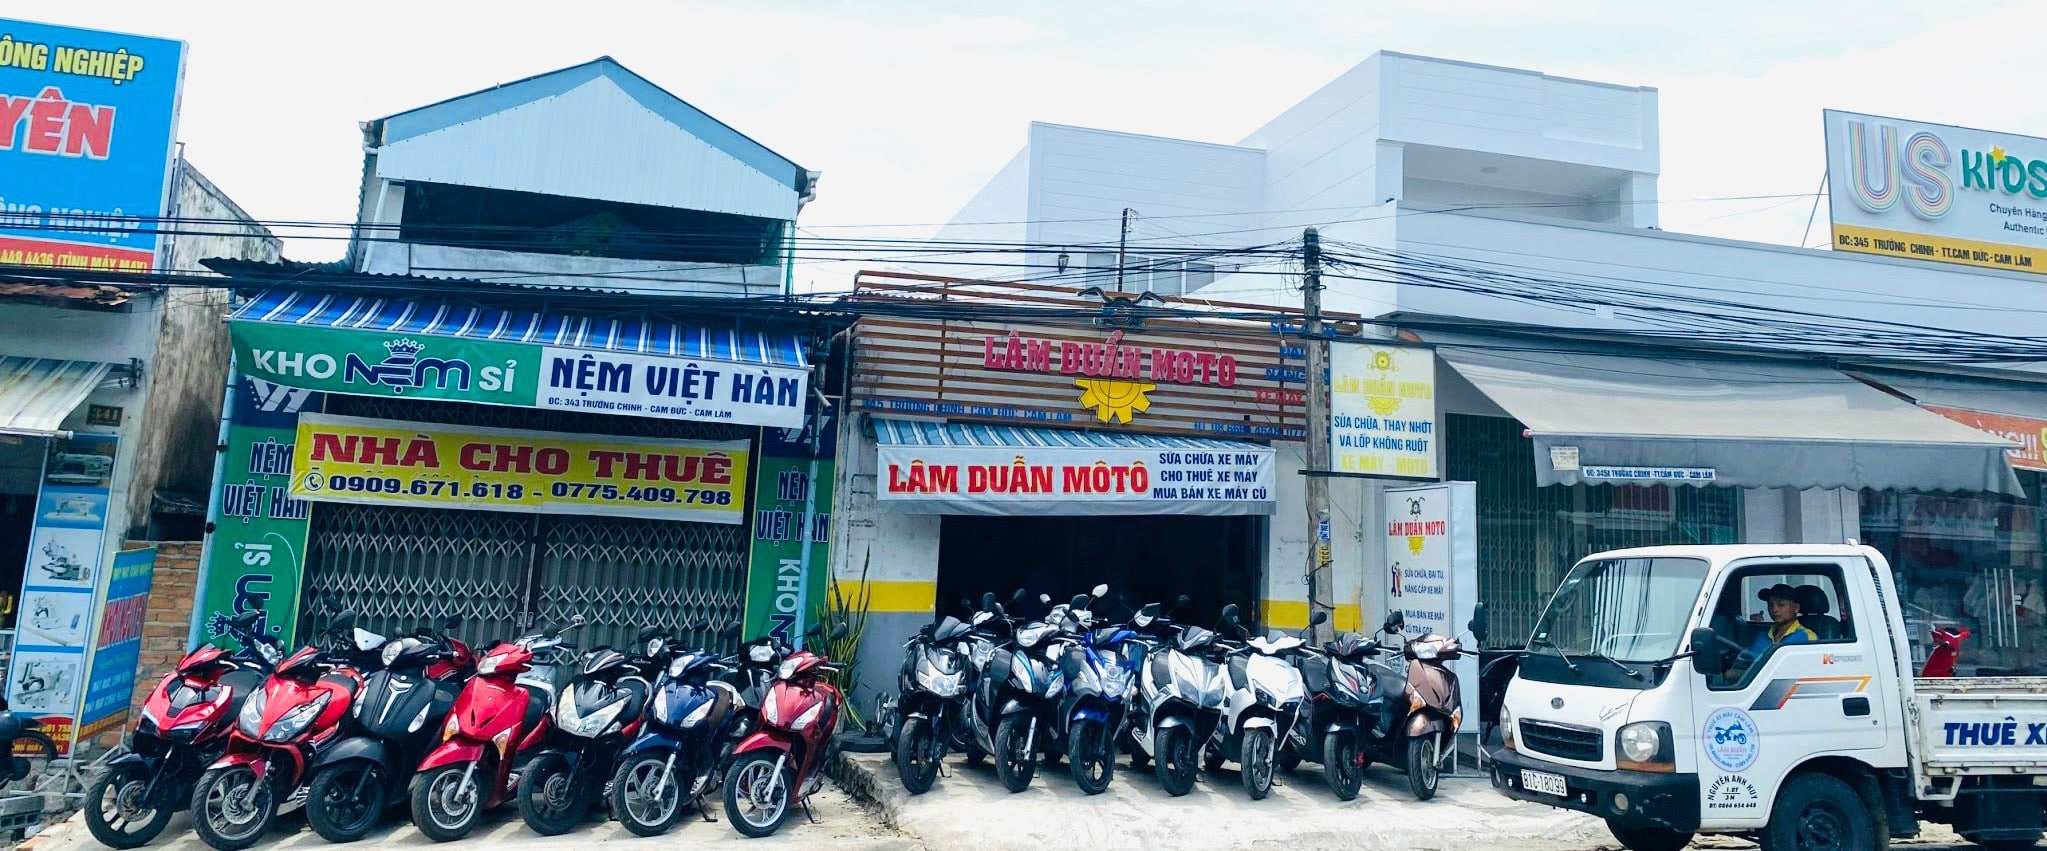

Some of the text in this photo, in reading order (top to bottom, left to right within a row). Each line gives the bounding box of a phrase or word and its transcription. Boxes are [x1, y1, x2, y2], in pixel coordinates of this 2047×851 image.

[53, 47, 144, 85] NGHIỆP
[1847, 120, 1954, 222] US
[1989, 203, 2023, 218] Chuyên
[252, 349, 337, 379] KHO
[478, 359, 518, 392] SỈ
[984, 330, 1052, 372] LÂM
[1150, 347, 1237, 387] MOTO
[550, 354, 799, 408] NỆM VIỆT HÀN
[564, 398, 580, 407] 343
[617, 401, 642, 412] CHINH
[650, 404, 668, 414] CAM
[694, 407, 712, 418] CAM
[714, 408, 732, 419] LÂM
[1384, 418, 1407, 433] THAY
[310, 433, 732, 485] NHÀ CHO THUÊ
[1159, 452, 1259, 466] SỬA CHỮA XE MÁY
[1373, 435, 1403, 451] KHÔNG
[1405, 437, 1429, 455] RUỘT
[328, 475, 524, 500] 0909.671.618
[551, 482, 732, 506] 0775.409.798
[888, 458, 959, 494] LÂM
[1063, 460, 1148, 494] MÔTÔ
[1160, 468, 1258, 483] CHO THUÊ XE MÁY
[223, 479, 266, 523] VIỆT
[1153, 485, 1267, 500] MUA BÁN XE MÁY CŨ
[756, 505, 793, 546] VIỆT
[1425, 520, 1446, 536] MOTO
[1943, 715, 2047, 746] THUÊ X
[1731, 774, 1747, 786] ANH
[1746, 783, 1759, 799] HUY
